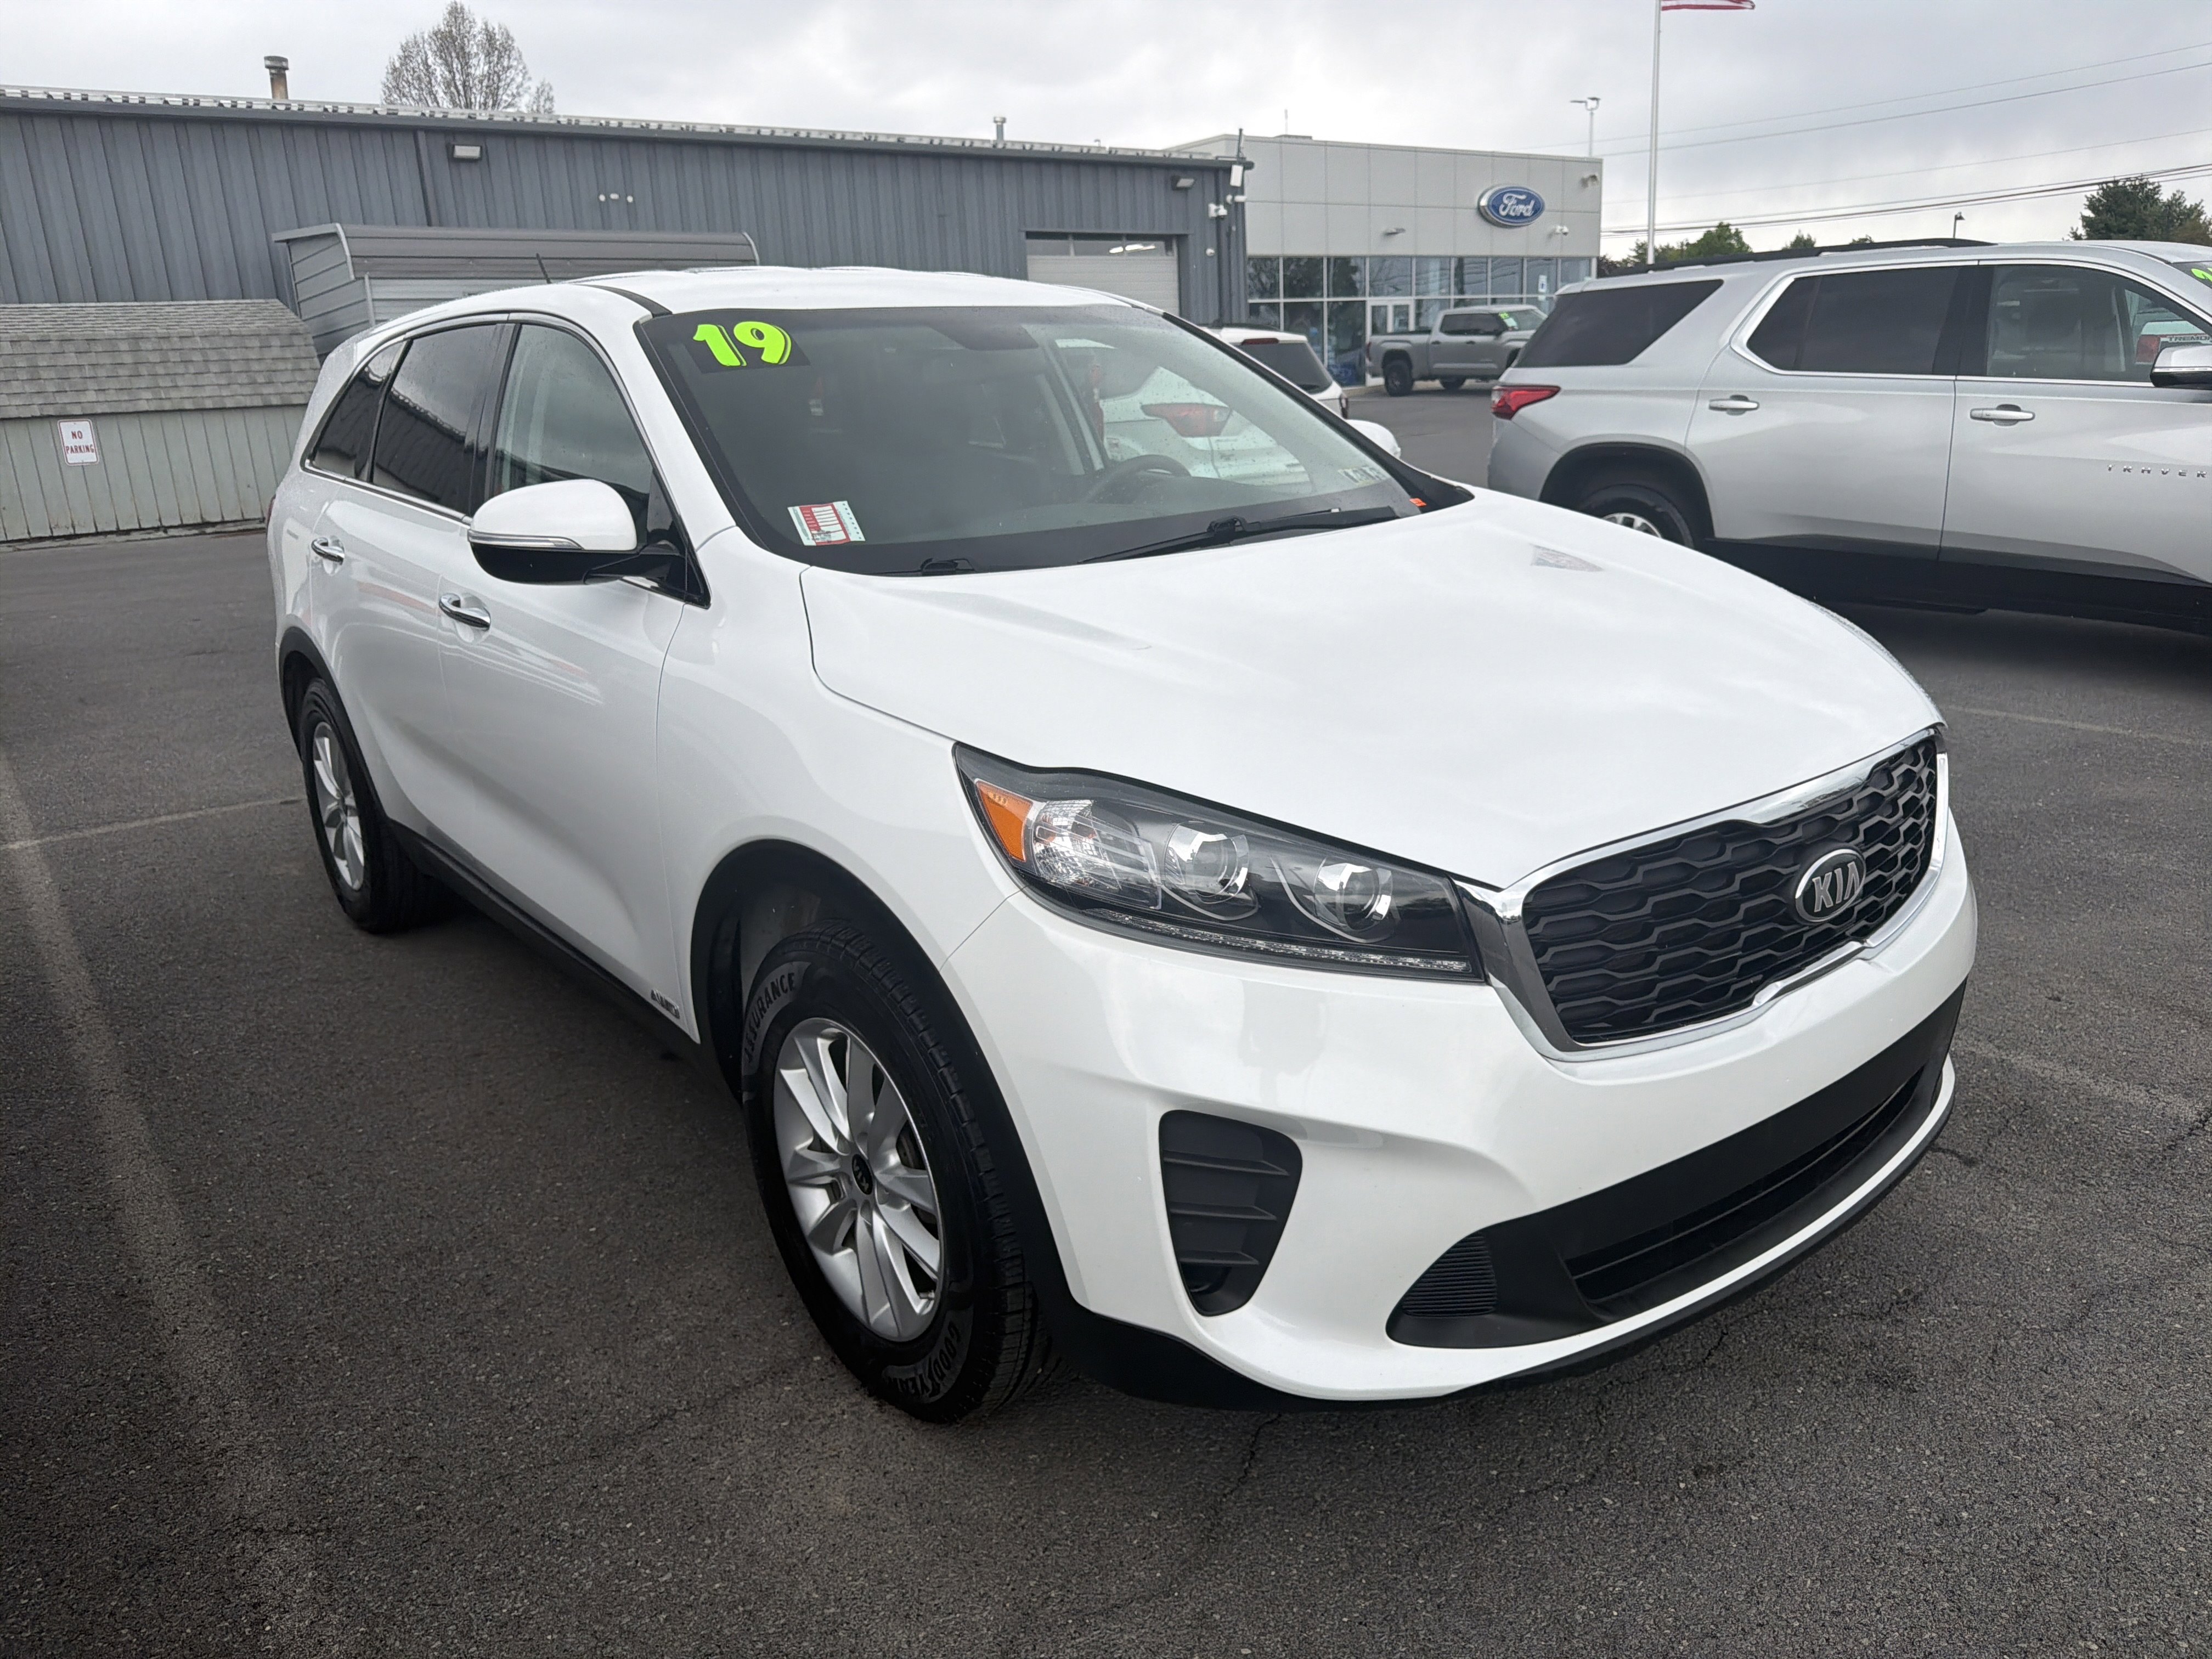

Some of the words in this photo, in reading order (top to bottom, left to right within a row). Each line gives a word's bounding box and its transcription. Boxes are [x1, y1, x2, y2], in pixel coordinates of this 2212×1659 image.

[1499, 193, 1536, 217] Ford
[693, 321, 792, 366] 19
[71, 430, 83, 439] NO
[65, 443, 94, 454] PARKING
[1812, 861, 1860, 912] KIA
